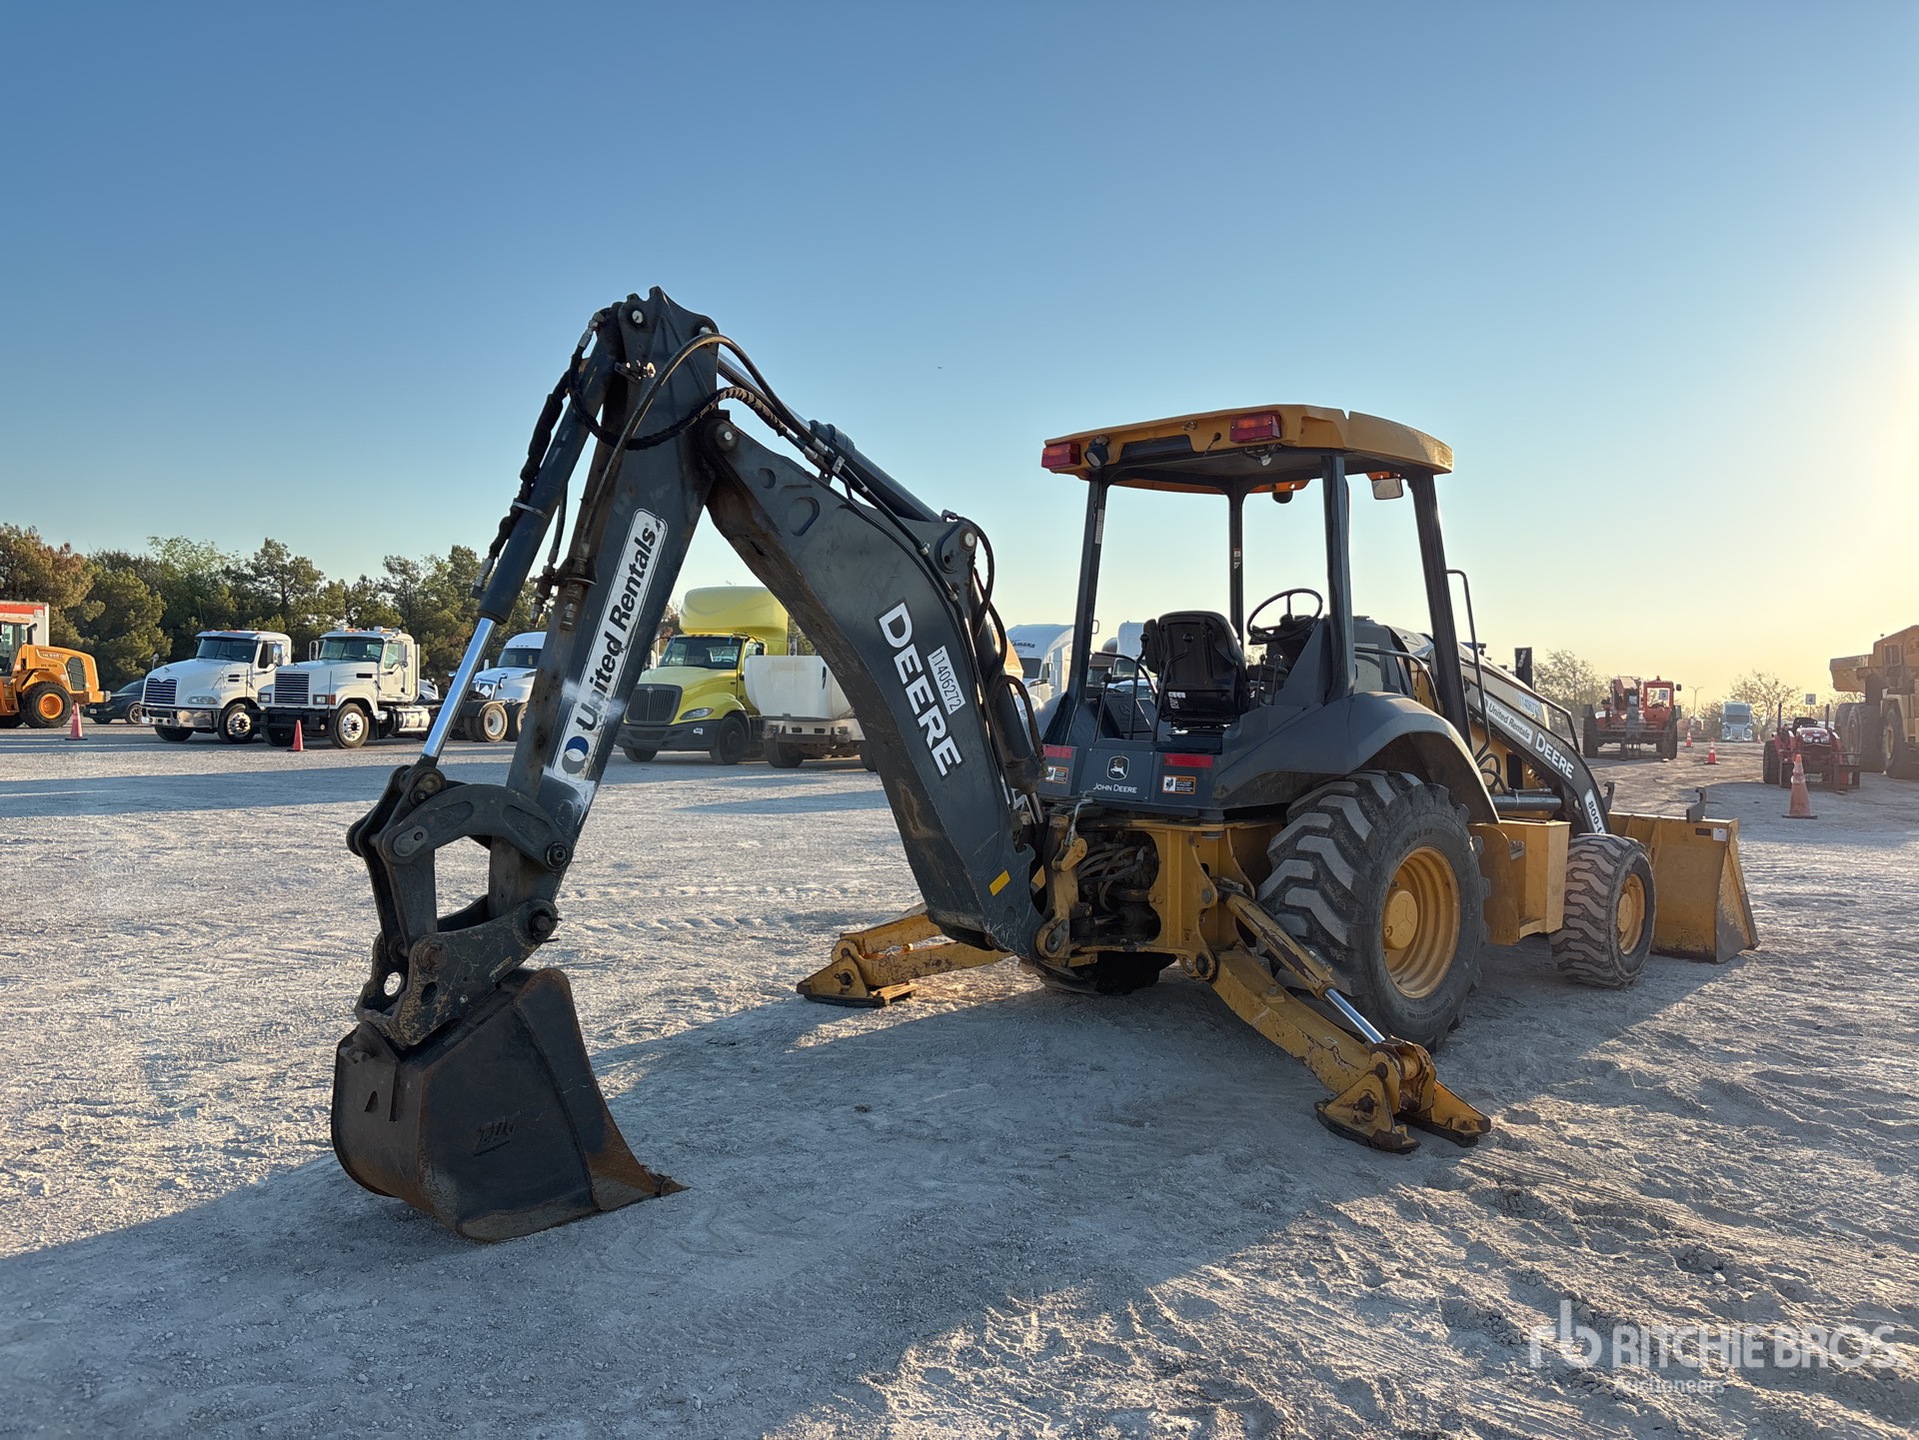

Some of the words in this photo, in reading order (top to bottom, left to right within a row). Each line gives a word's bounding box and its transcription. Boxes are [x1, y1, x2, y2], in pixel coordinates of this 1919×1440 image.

[878, 602, 962, 776] DEERE
[931, 649, 962, 712] 11406272
[1488, 702, 1510, 724] United
[1508, 718, 1531, 739] Rentals
[1535, 732, 1575, 780] DEERE
[1093, 783, 1112, 791] JOHN
[1113, 784, 1138, 794] DEERE
